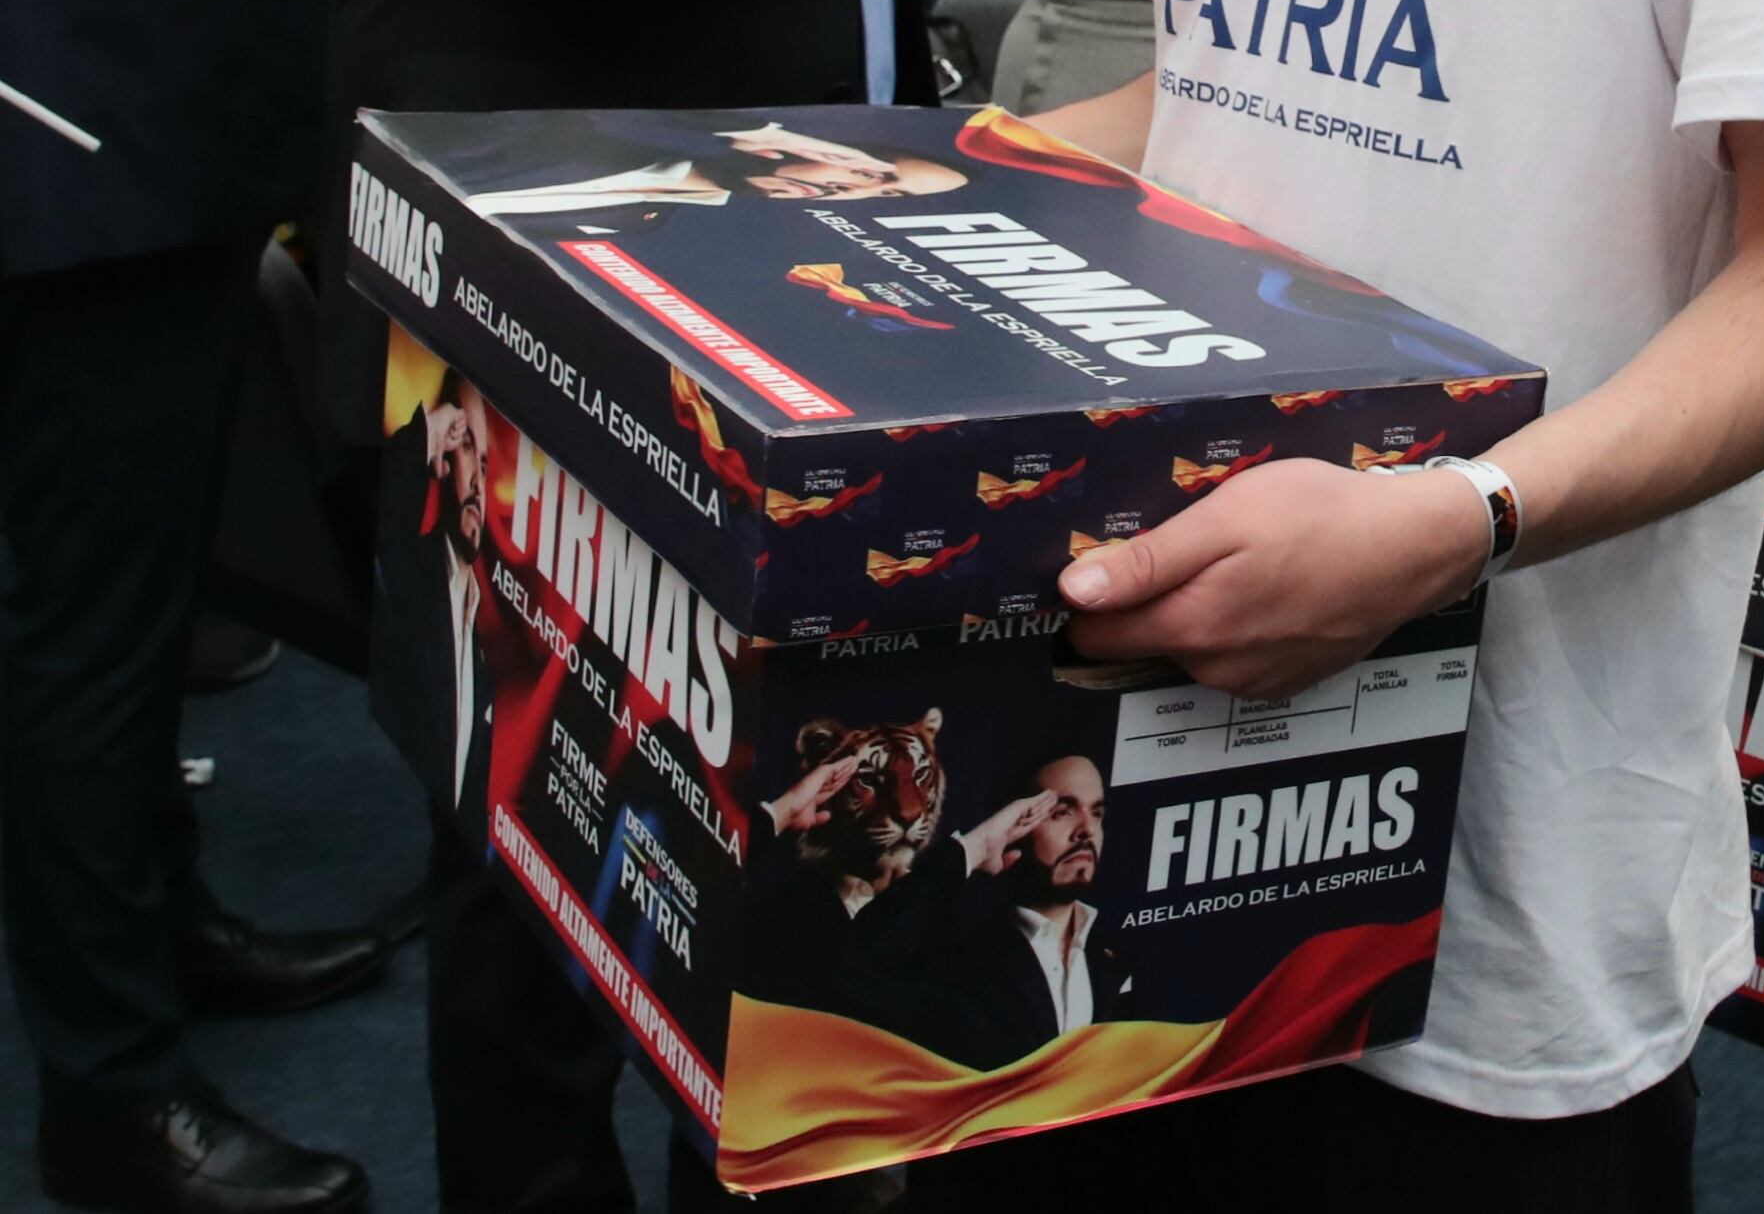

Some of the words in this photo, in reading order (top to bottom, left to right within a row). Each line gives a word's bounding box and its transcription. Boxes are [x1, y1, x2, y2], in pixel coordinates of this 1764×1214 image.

[1232, 90, 1263, 117] DE
[1264, 99, 1288, 128] LA
[1294, 108, 1463, 170] ESPRIELLA
[573, 243, 666, 294] CONTENIDO
[642, 295, 741, 348] ALTAMENTE
[717, 348, 838, 416] IMPORTANTE
[804, 208, 928, 274] ABELARDO
[913, 274, 964, 293] DE
[947, 293, 993, 312] LA
[980, 312, 1128, 386] ESPRIELLA
[872, 212, 1267, 368] FIRMAS
[349, 161, 443, 309] FIRMAS
[453, 276, 548, 374] ABELARDO
[550, 352, 577, 400] DE
[579, 377, 604, 425] LA
[608, 402, 722, 528] ESPRIELLA
[511, 433, 739, 769] FIRMAS
[821, 632, 919, 659] PATRIA
[1361, 679, 1408, 693] PLANILLAS
[1373, 670, 1400, 680] TOTAL
[1436, 670, 1468, 682] FIRMAS
[1441, 660, 1467, 670] TOTAL
[491, 560, 581, 675] ABELARDO
[582, 657, 605, 709] DE
[609, 685, 633, 741] LA
[636, 720, 743, 867] ESPRIELLA
[1156, 701, 1194, 715] CIUDAD
[1157, 736, 1186, 747] TOMO
[1232, 733, 1290, 747] APROBADAS
[1238, 722, 1287, 735] PLANILLAS
[551, 718, 607, 807] FIRME
[560, 765, 579, 796] POR
[580, 788, 591, 813] LA
[547, 771, 599, 855] PATRIA
[1146, 766, 1419, 893] FIRMAS
[625, 806, 698, 909] DEFENSORES
[1121, 892, 1244, 929] ABELARDO
[1249, 885, 1278, 905] DE
[1282, 879, 1310, 900] LA
[1315, 858, 1427, 893] ESPRIELLA
[620, 851, 691, 971] PATRIA
[494, 803, 560, 913] CONTENIDO
[558, 893, 631, 1007] ALTAMENTE
[630, 983, 723, 1128] IMPORTANTE
